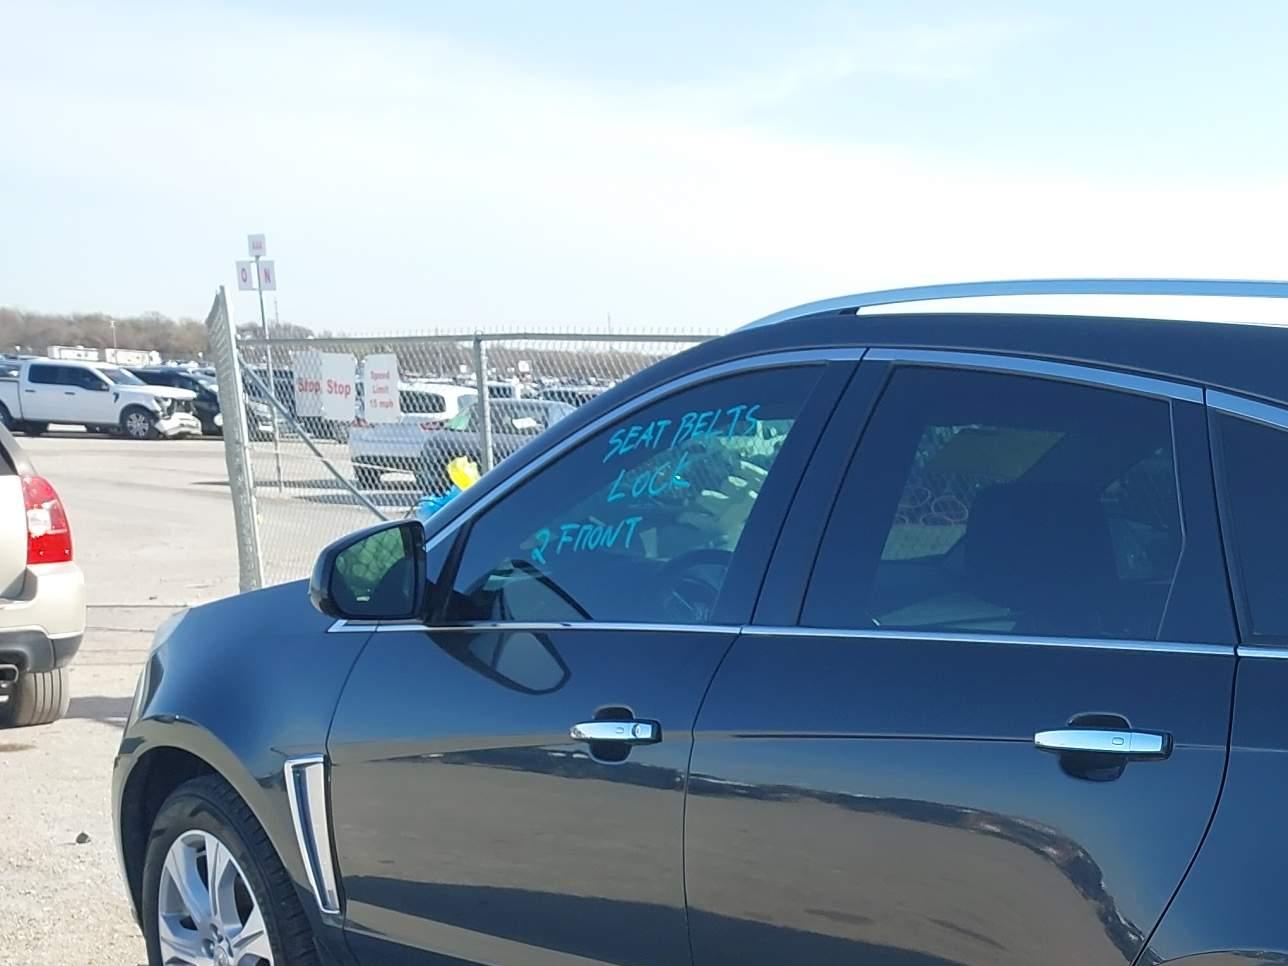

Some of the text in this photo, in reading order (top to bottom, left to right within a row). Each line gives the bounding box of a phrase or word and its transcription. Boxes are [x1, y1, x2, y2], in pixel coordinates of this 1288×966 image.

[297, 377, 321, 393] Stop
[326, 379, 352, 399] Stop
[379, 400, 394, 409] mph
[603, 405, 761, 463] SEAT BELTS
[607, 451, 690, 502] LOCK
[555, 516, 643, 555] FRONT
